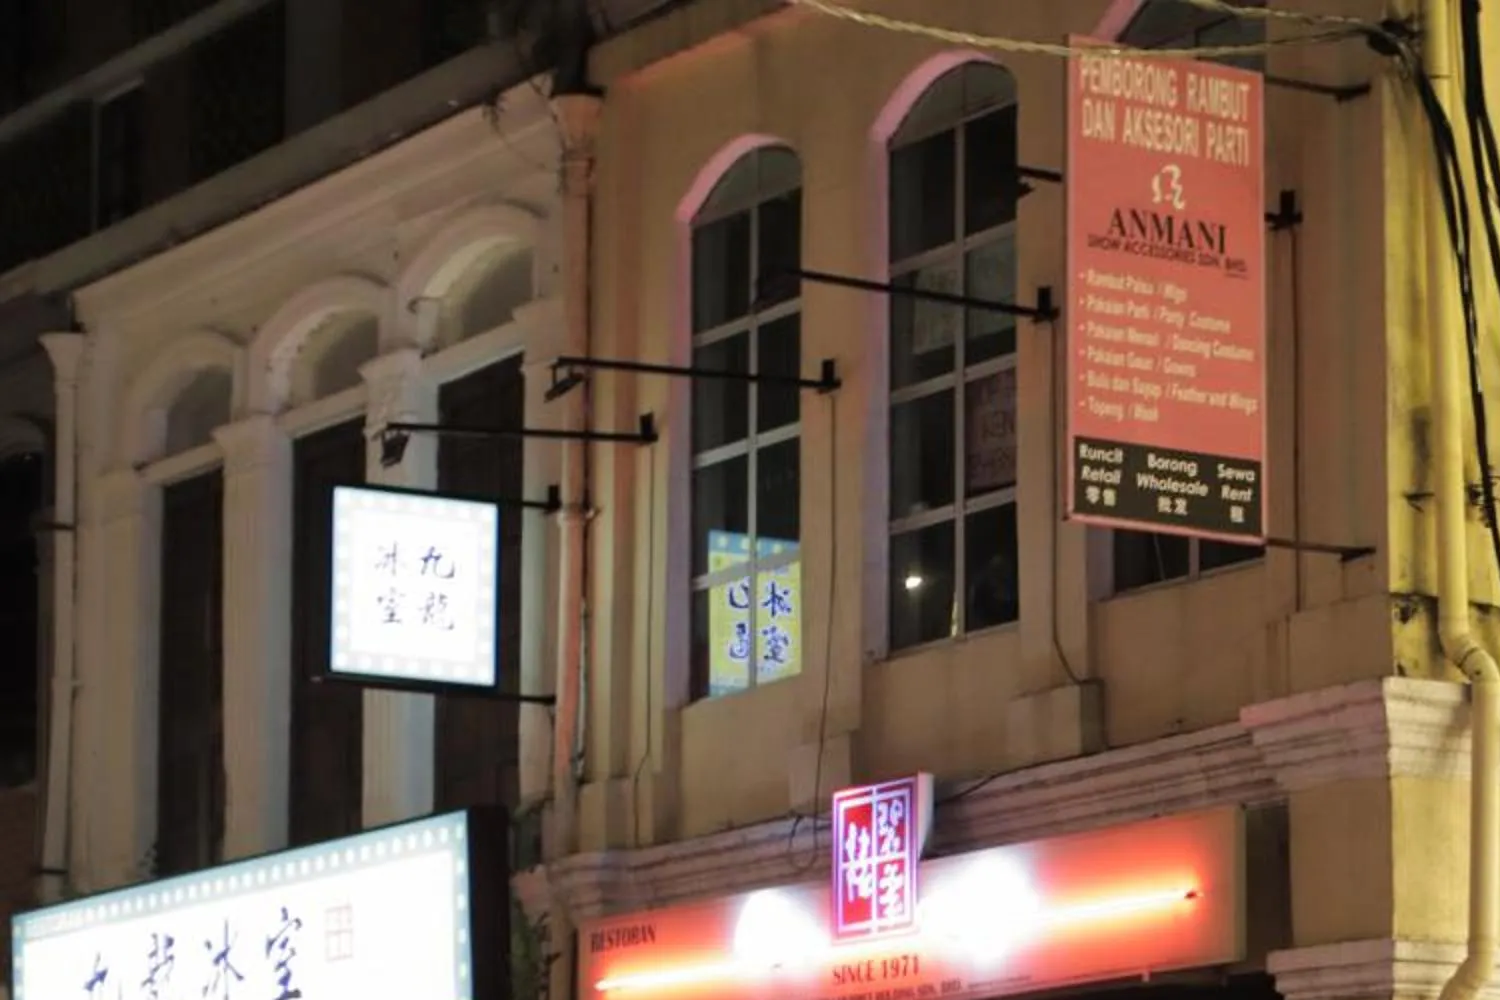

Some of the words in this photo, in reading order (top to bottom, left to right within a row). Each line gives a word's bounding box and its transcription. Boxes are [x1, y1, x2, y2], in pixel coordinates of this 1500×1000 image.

[1187, 73, 1252, 122] RAMBUT
[1082, 98, 1116, 142] DAN
[1122, 106, 1200, 158] AKSESORI
[1206, 121, 1250, 167] PARTI
[1108, 207, 1226, 255] ANMANI
[1079, 443, 1124, 464] Runcit
[1147, 453, 1198, 477] Borong
[1081, 465, 1122, 485] Retail
[1136, 472, 1209, 497] Wholesale
[1217, 463, 1256, 482] Sewa
[1221, 484, 1252, 502] Rent
[590, 924, 657, 954] RESTORAN
[831, 959, 875, 986] SINCE
[881, 953, 920, 980] 1971
